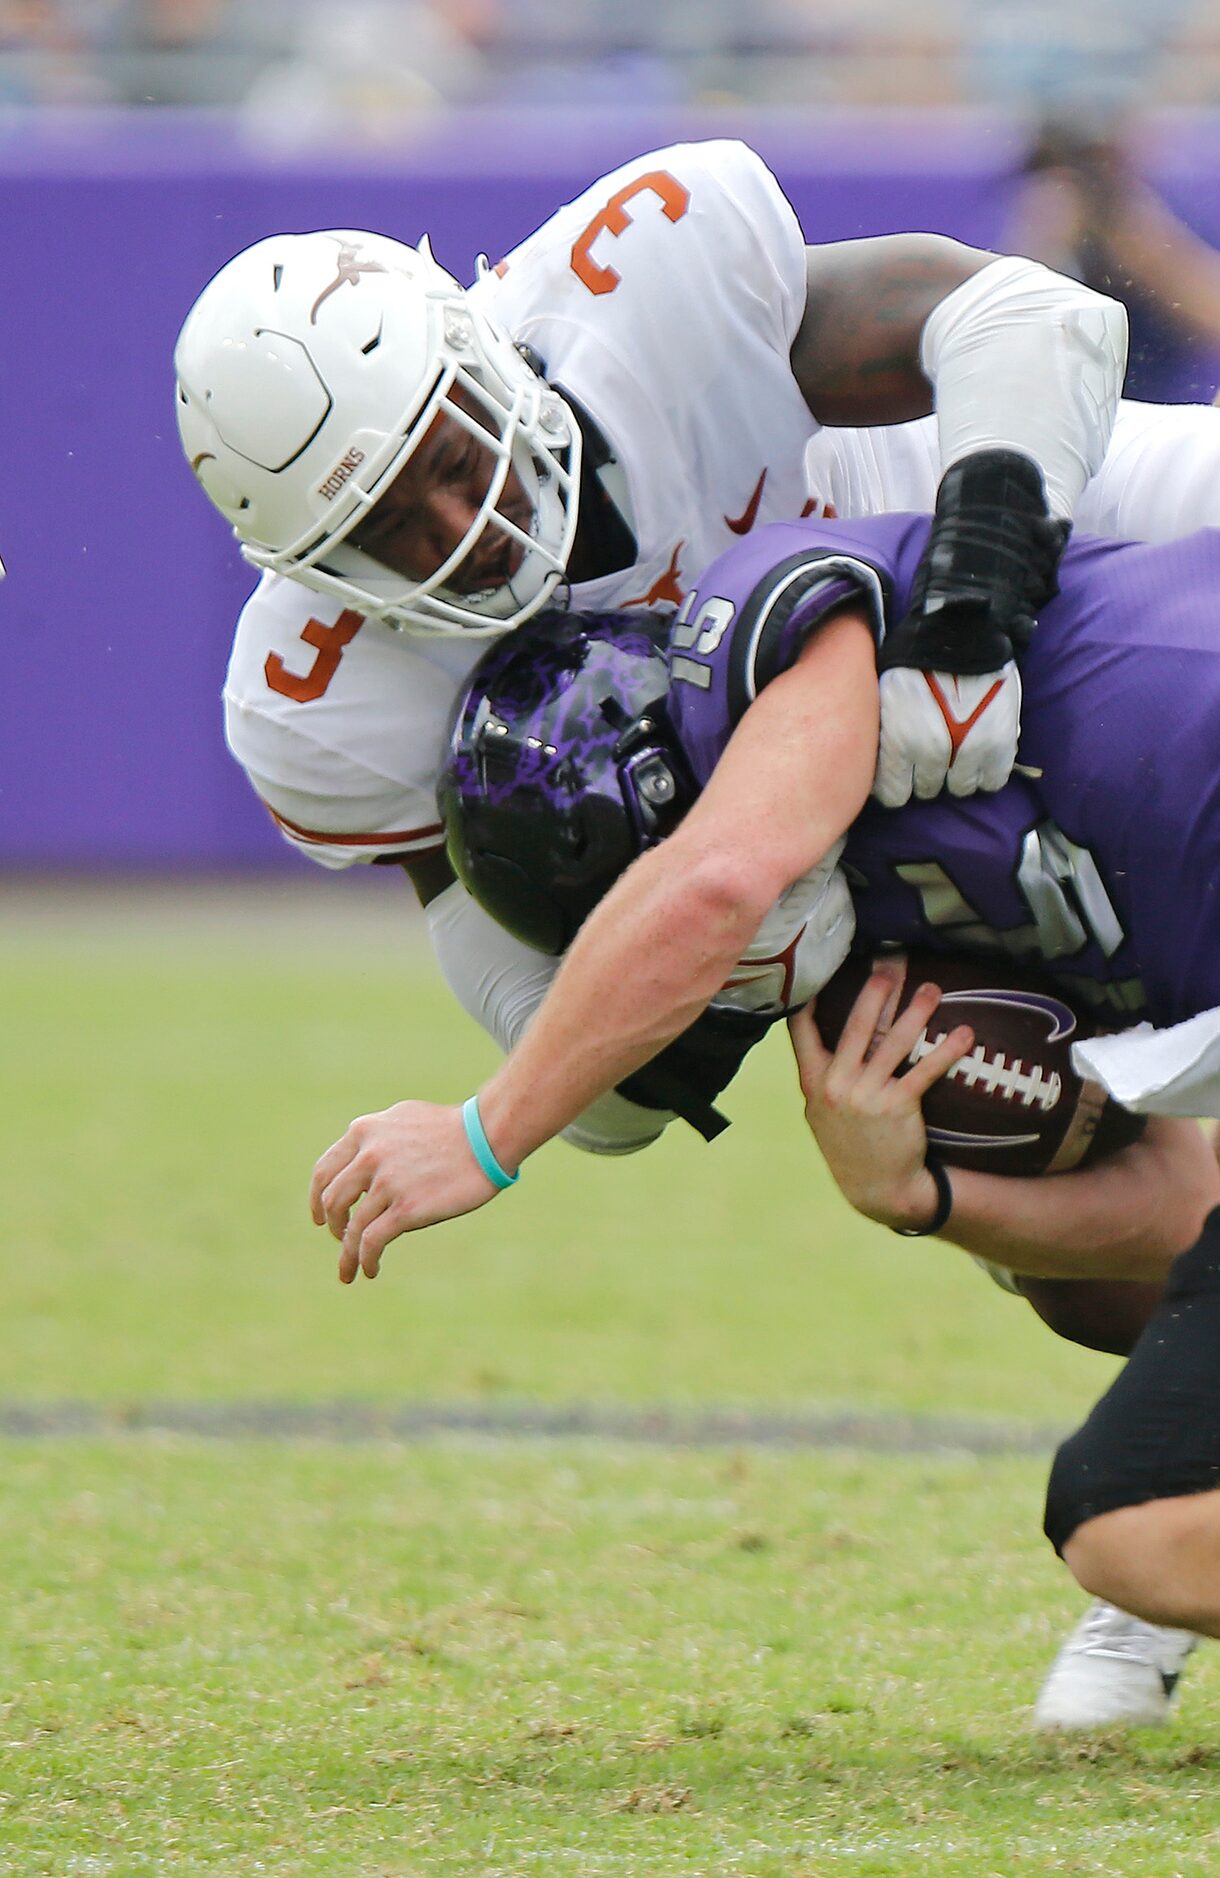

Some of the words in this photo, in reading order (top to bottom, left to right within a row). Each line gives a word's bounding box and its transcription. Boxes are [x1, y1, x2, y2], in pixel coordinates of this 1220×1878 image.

[570, 169, 691, 296] 3
[318, 446, 366, 502] HORNS
[669, 588, 737, 692] 15
